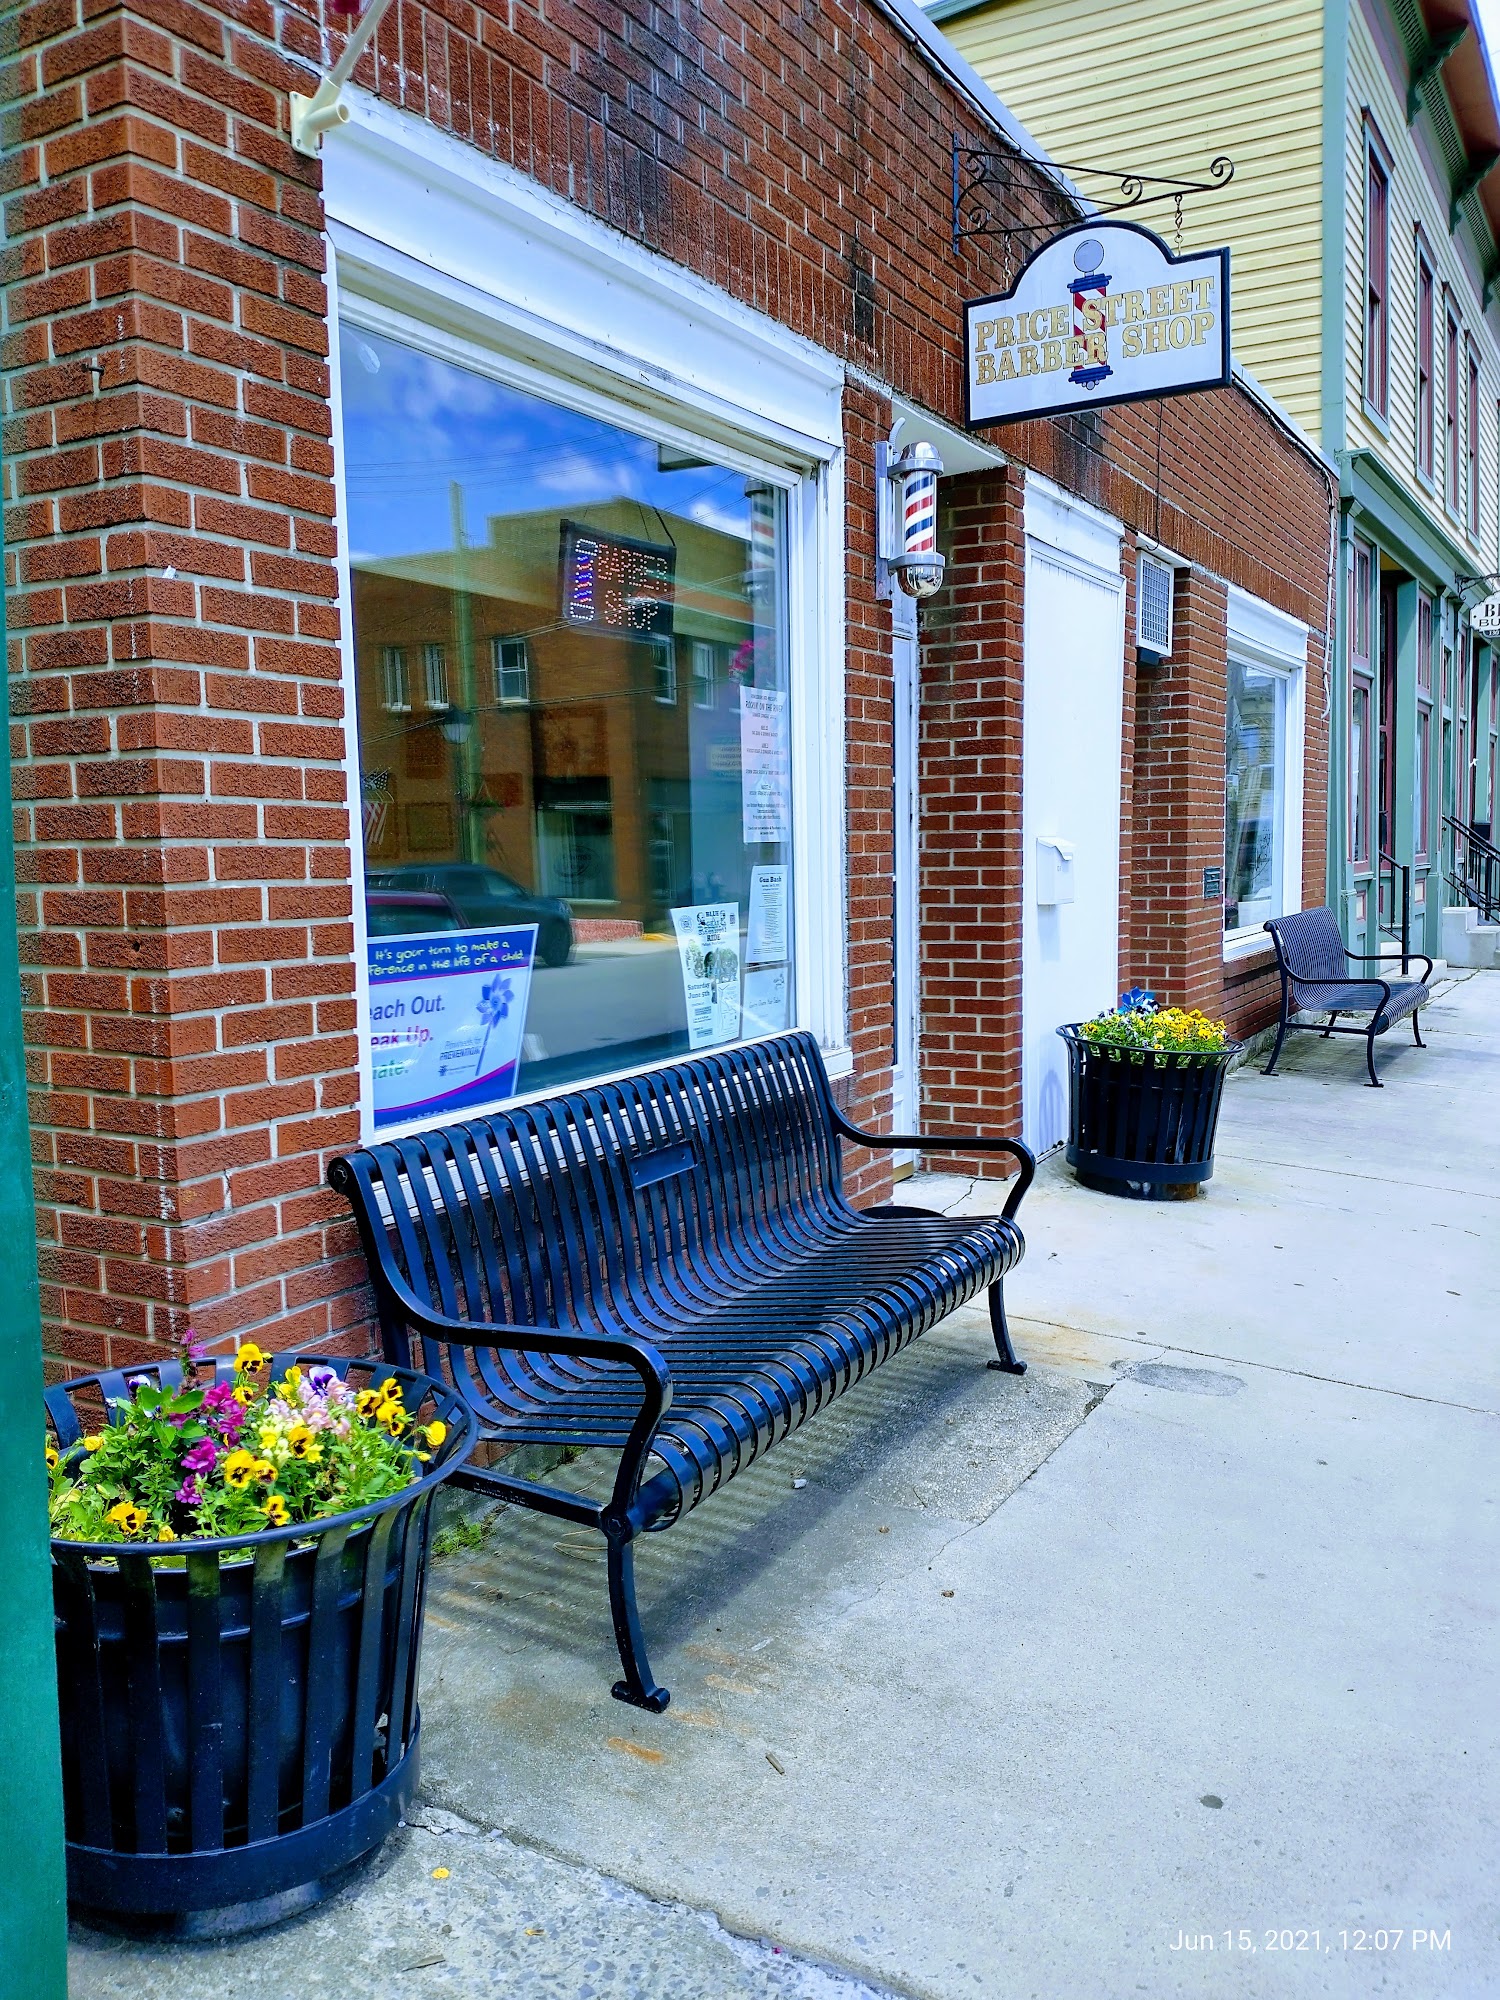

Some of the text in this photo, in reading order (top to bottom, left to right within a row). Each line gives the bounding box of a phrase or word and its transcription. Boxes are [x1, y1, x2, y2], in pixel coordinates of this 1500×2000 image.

[975, 276, 1214, 352] PRICE STREET
[975, 312, 1214, 385] BARBER SHOP
[598, 543, 668, 593] BARBER
[604, 590, 659, 631] SHOP
[375, 948, 393, 960] It's
[396, 949, 425, 964] your
[428, 946, 452, 955] turn
[455, 943, 469, 953] to
[471, 940, 499, 951] make
[418, 963, 428, 971] in
[431, 959, 450, 969] the
[453, 955, 471, 967] life
[474, 952, 490, 966] of
[687, 982, 710, 991] Saturday
[411, 994, 446, 1015] Out.
[406, 1025, 434, 1048] Up.
